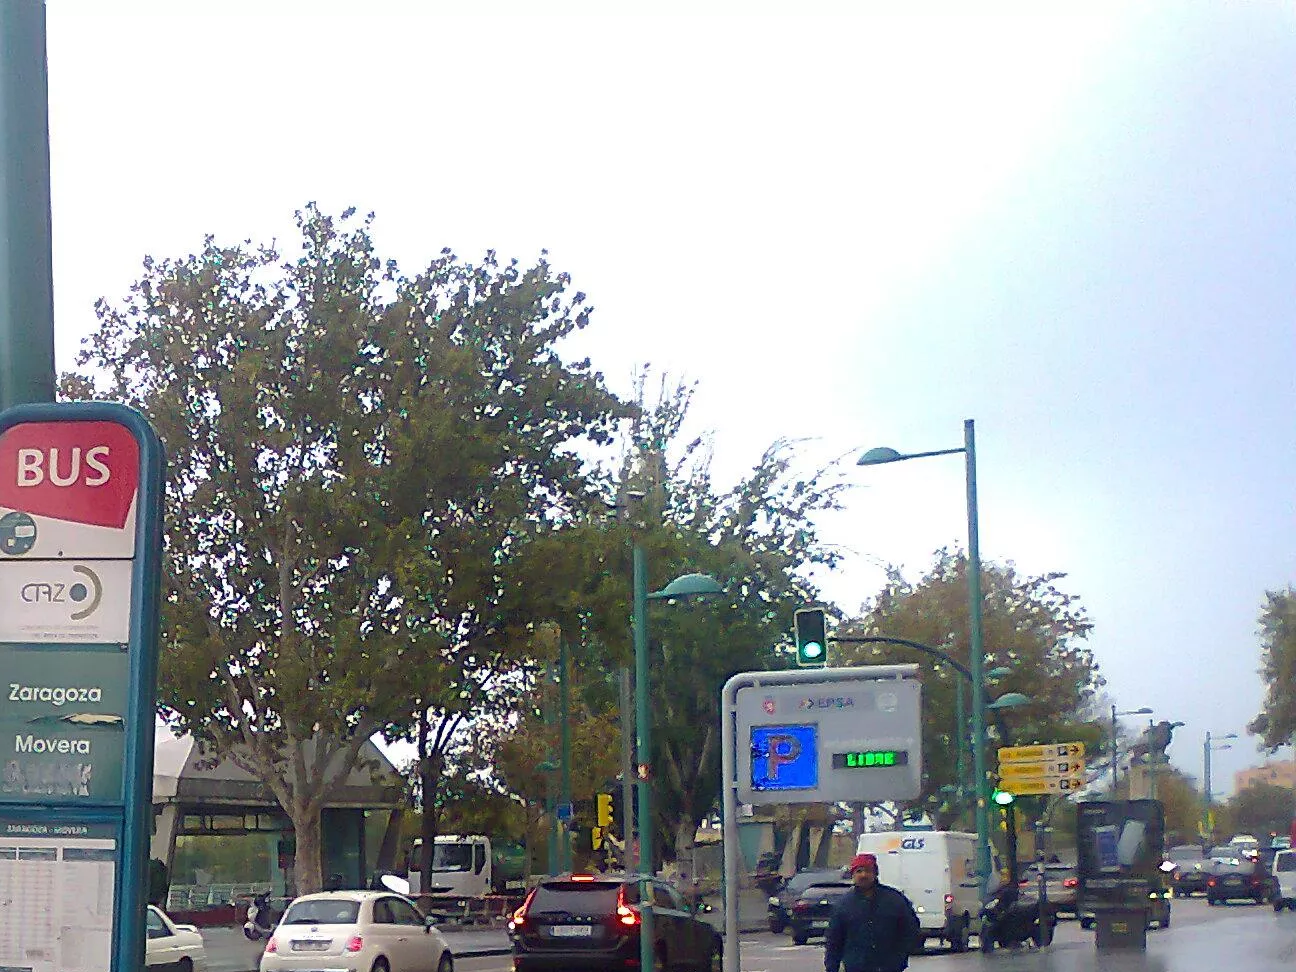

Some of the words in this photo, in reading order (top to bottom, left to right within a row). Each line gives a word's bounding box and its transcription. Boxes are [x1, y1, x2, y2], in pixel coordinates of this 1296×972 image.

[17, 446, 110, 487] BUS
[21, 583, 65, 602] CTAZ
[8, 683, 102, 706] Zaragoza
[15, 734, 90, 754] Movera
[767, 734, 802, 780] P
